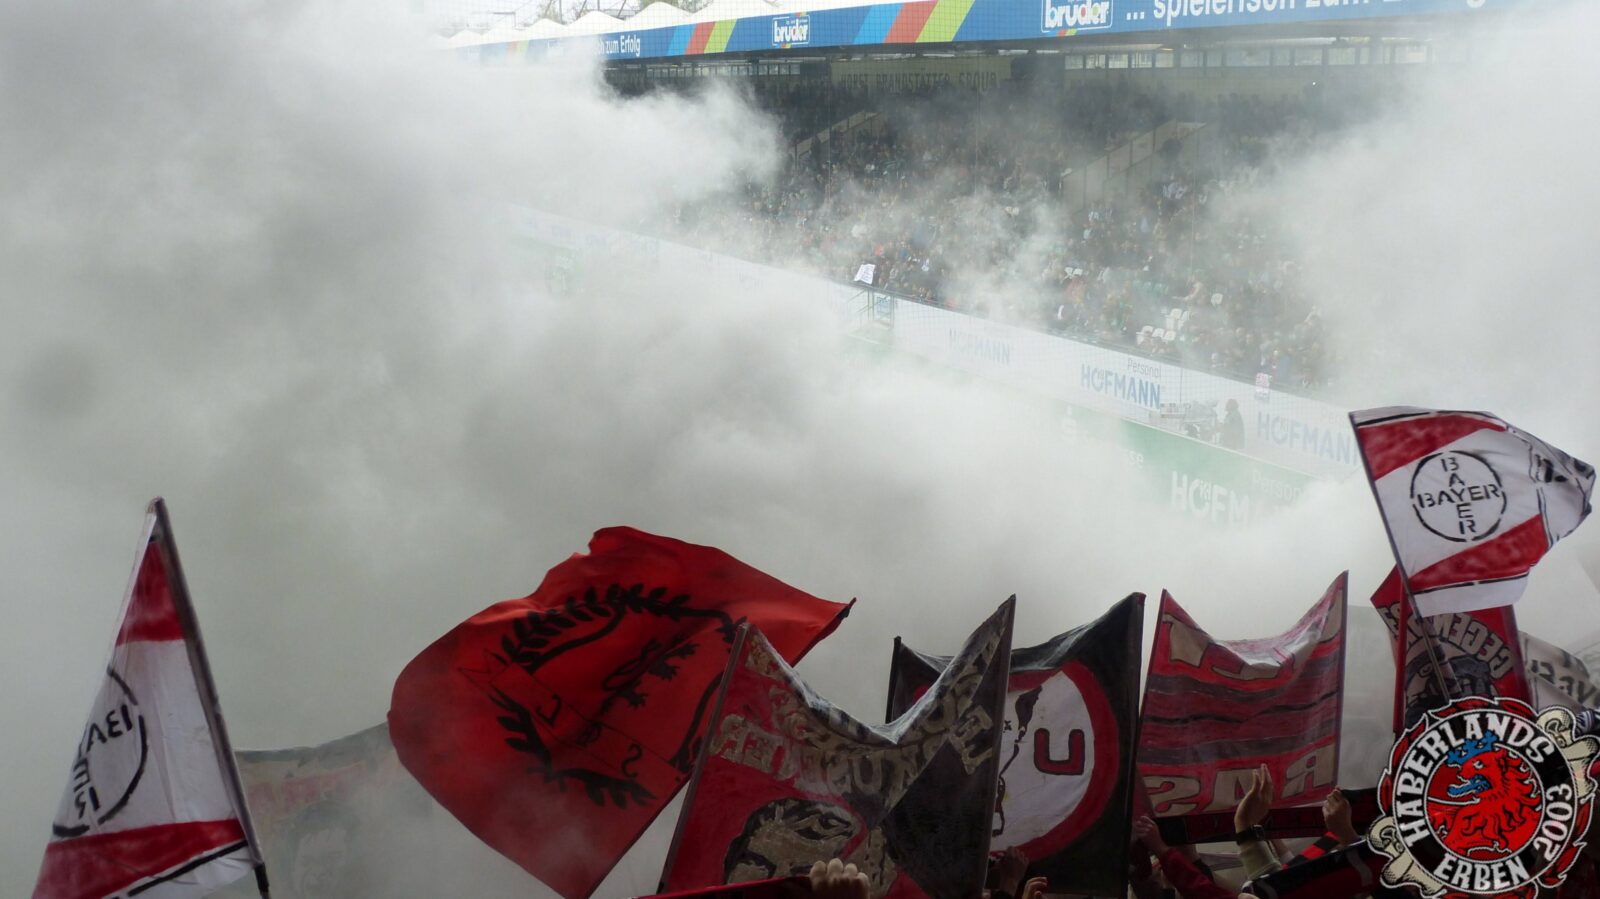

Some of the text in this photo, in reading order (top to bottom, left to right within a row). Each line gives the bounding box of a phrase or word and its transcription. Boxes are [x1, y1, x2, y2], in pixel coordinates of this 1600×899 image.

[606, 40, 620, 54] zum
[620, 35, 641, 57] Erfolg
[1081, 363, 1161, 409] HOFMANN
[1416, 484, 1501, 509] BAYER
[1440, 456, 1477, 535] BAYER
